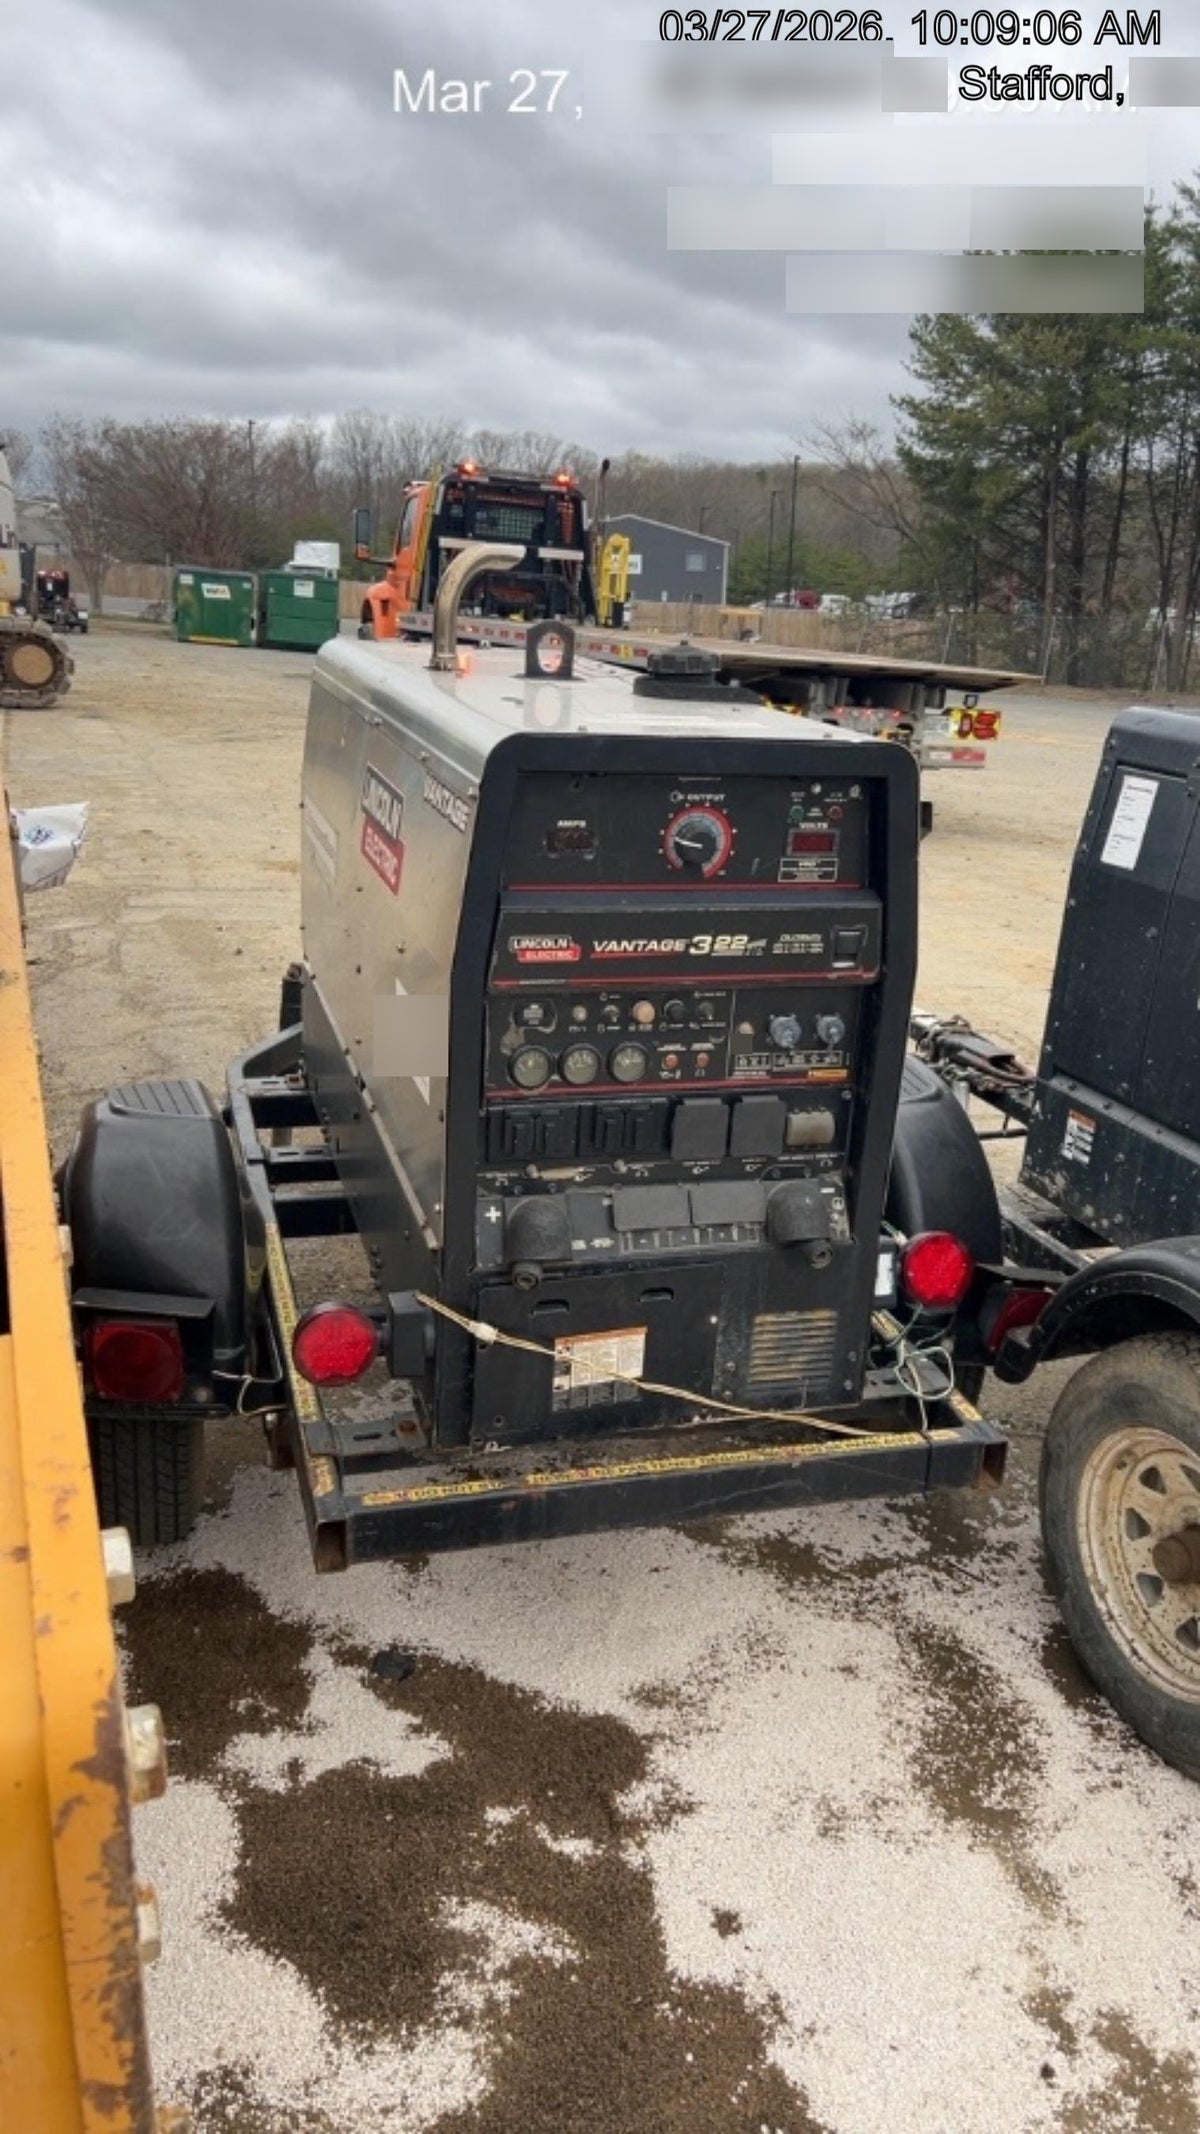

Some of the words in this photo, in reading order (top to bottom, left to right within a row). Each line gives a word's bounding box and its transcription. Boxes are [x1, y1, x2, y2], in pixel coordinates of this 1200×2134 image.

[514, 938, 570, 950] LINCOLN
[593, 939, 691, 953] VANTAGE
[690, 933, 750, 955] 322
[525, 950, 576, 960] ELECTRIC
